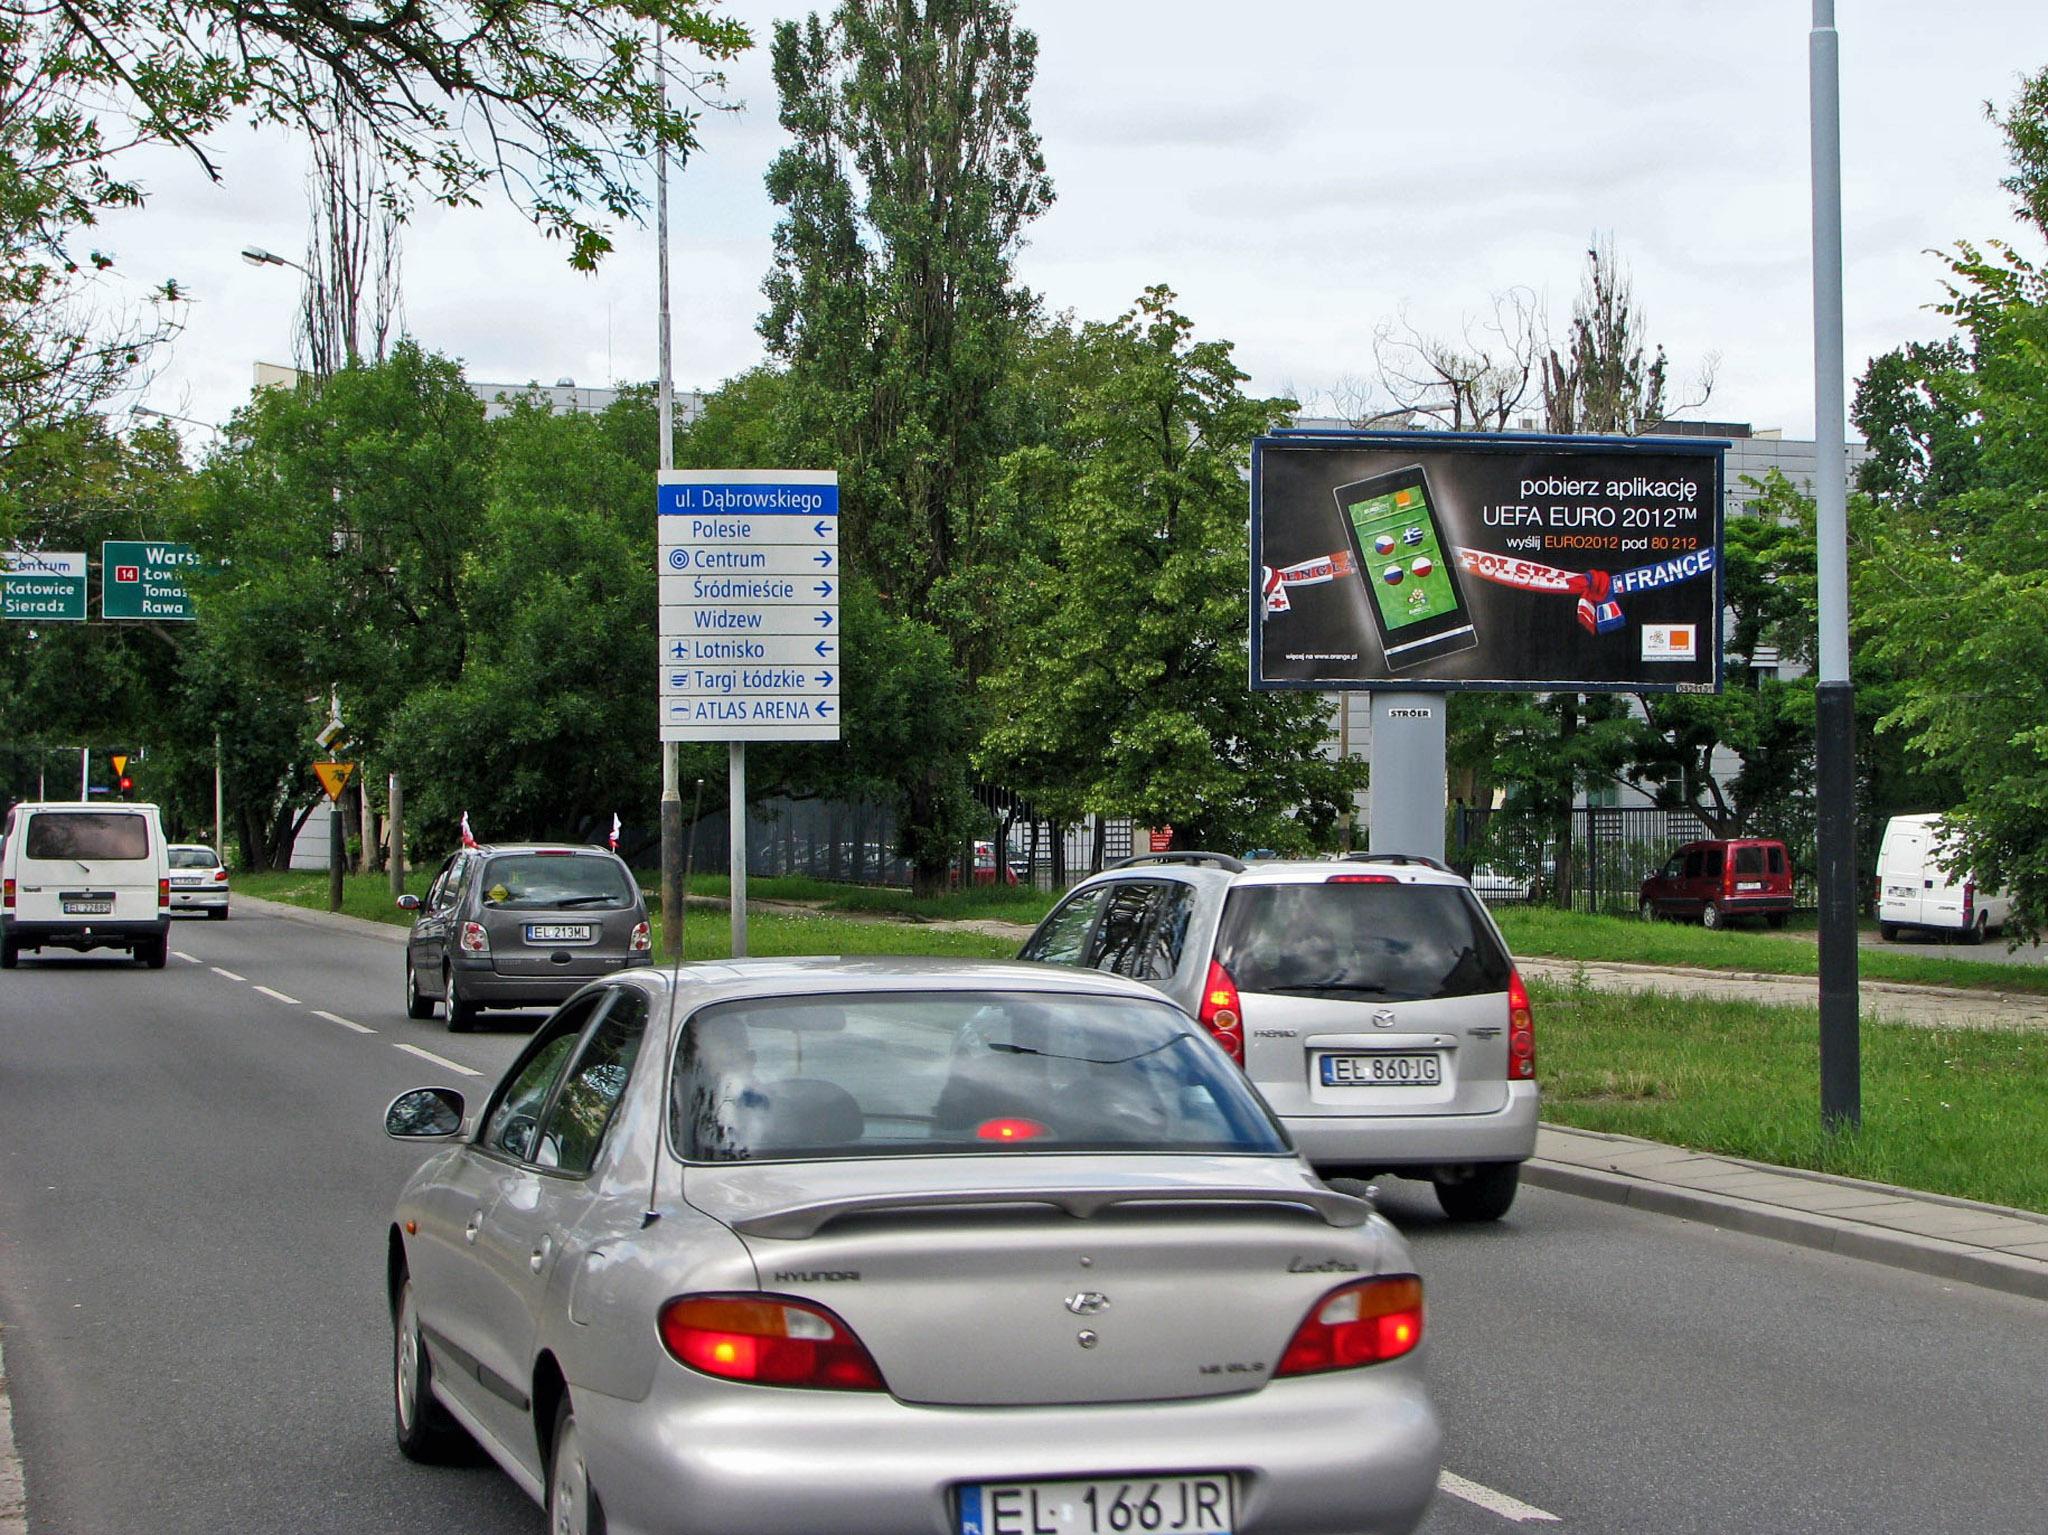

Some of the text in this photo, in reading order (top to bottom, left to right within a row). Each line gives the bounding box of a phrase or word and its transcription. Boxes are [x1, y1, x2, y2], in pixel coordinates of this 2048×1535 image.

[1520, 476, 1698, 501] pobierz aplikację
[675, 489, 823, 512] ul. Dąbrowskiego
[1483, 505, 1543, 526] UEFA
[1550, 506, 1616, 527] EURO
[692, 520, 751, 538] Polesie
[1506, 535, 1697, 551] wyślij EURO2012 pod 80 212
[7, 558, 71, 571] Centrum
[694, 550, 766, 568] Centrum
[121, 569, 134, 580] 14
[1460, 550, 1571, 589] POLSKA
[1625, 549, 1712, 591] FRANCE
[6, 582, 75, 595] Katowice
[694, 575, 794, 598] Śródmieście
[6, 599, 65, 612] Sieradz
[142, 600, 183, 613] Rawa
[694, 611, 763, 629] Widzew
[695, 641, 765, 659] Lotnisko
[695, 670, 806, 693] Targi Łódzkie
[695, 701, 810, 719] ATLAS ARENA
[534, 925, 589, 938] EL 213ML
[1335, 1059, 1436, 1080] EL 860JG
[774, 1270, 862, 1282] HYUNDAI
[991, 1480, 1222, 1535] EL 166JR
